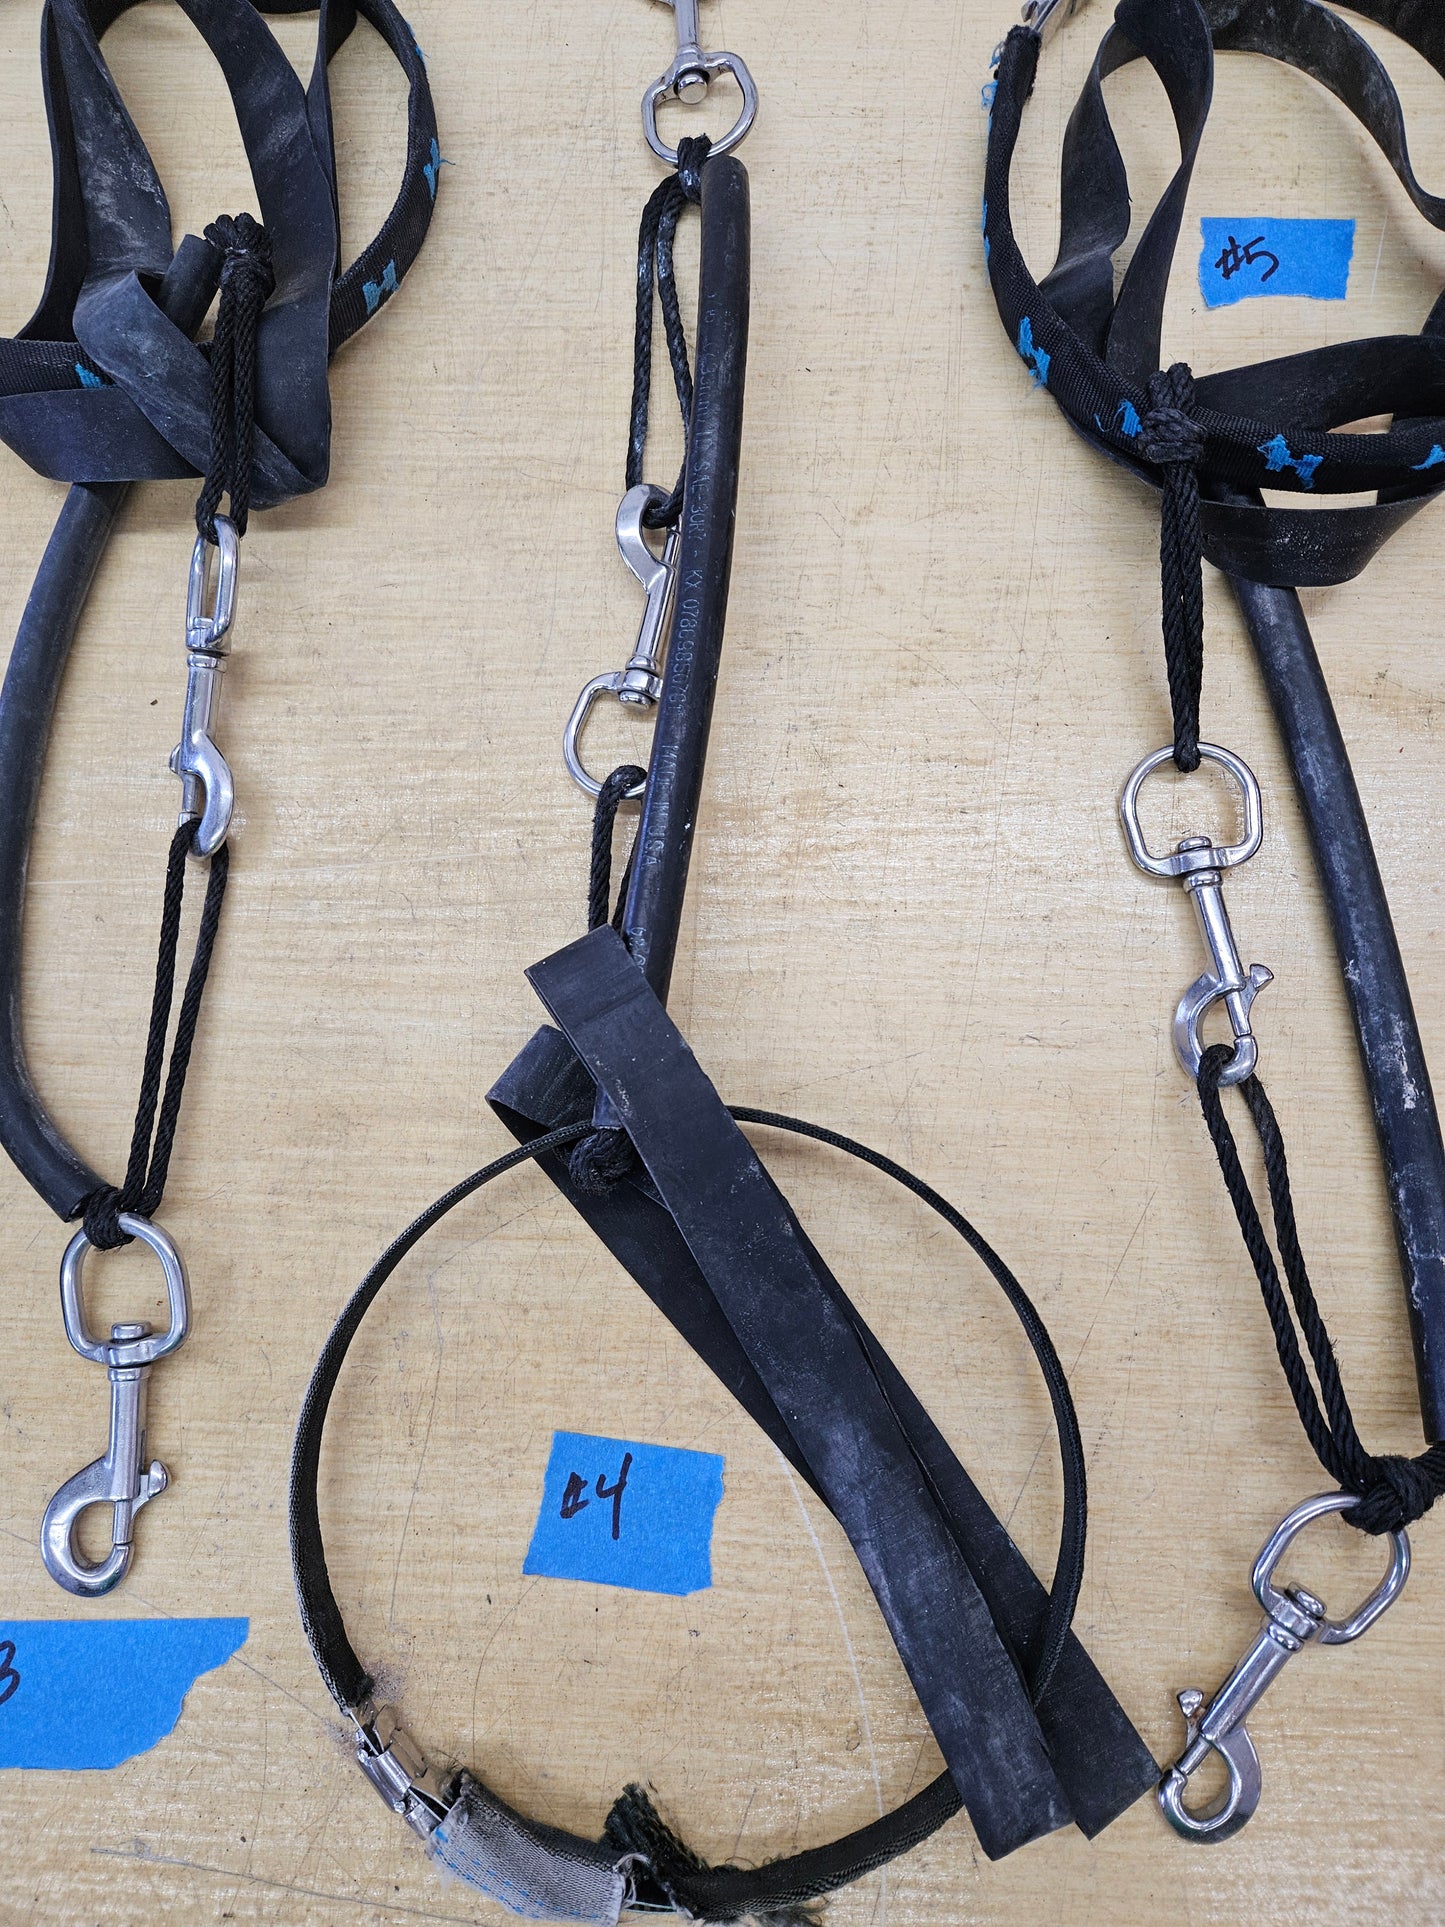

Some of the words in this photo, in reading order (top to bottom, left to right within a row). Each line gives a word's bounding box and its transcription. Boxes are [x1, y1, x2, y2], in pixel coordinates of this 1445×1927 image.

[1214, 235, 1280, 283] #5
[684, 569, 703, 592] KX
[560, 1452, 633, 1541] #4
[0, 1640, 21, 1706] 3
